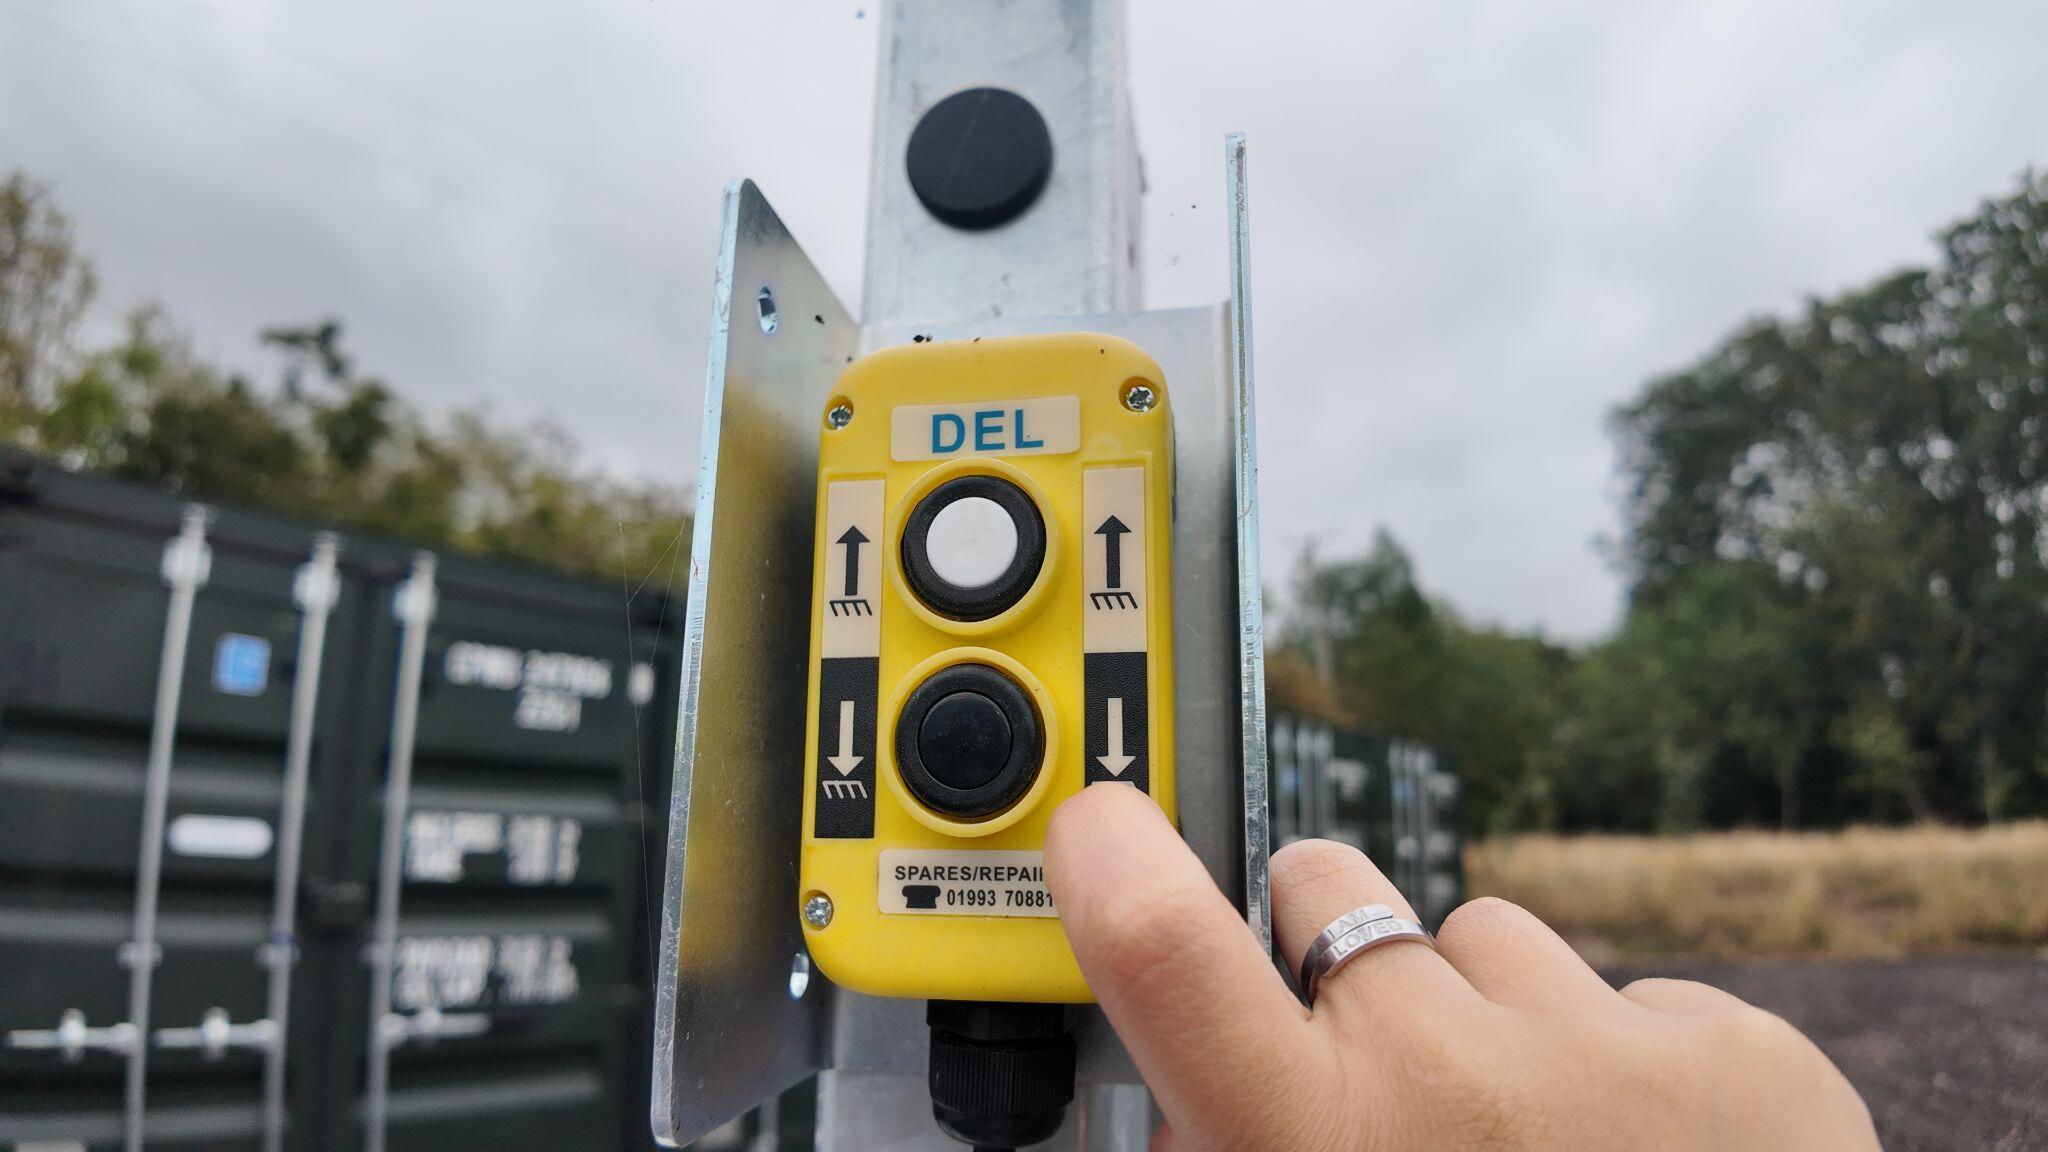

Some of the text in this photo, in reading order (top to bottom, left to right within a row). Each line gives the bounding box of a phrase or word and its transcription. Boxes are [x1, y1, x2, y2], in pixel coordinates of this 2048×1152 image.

[931, 409, 1044, 454] DEL
[946, 889, 1053, 908] 01993 70881
[1326, 909, 1370, 940] I AM
[1333, 919, 1403, 957] LOVED
